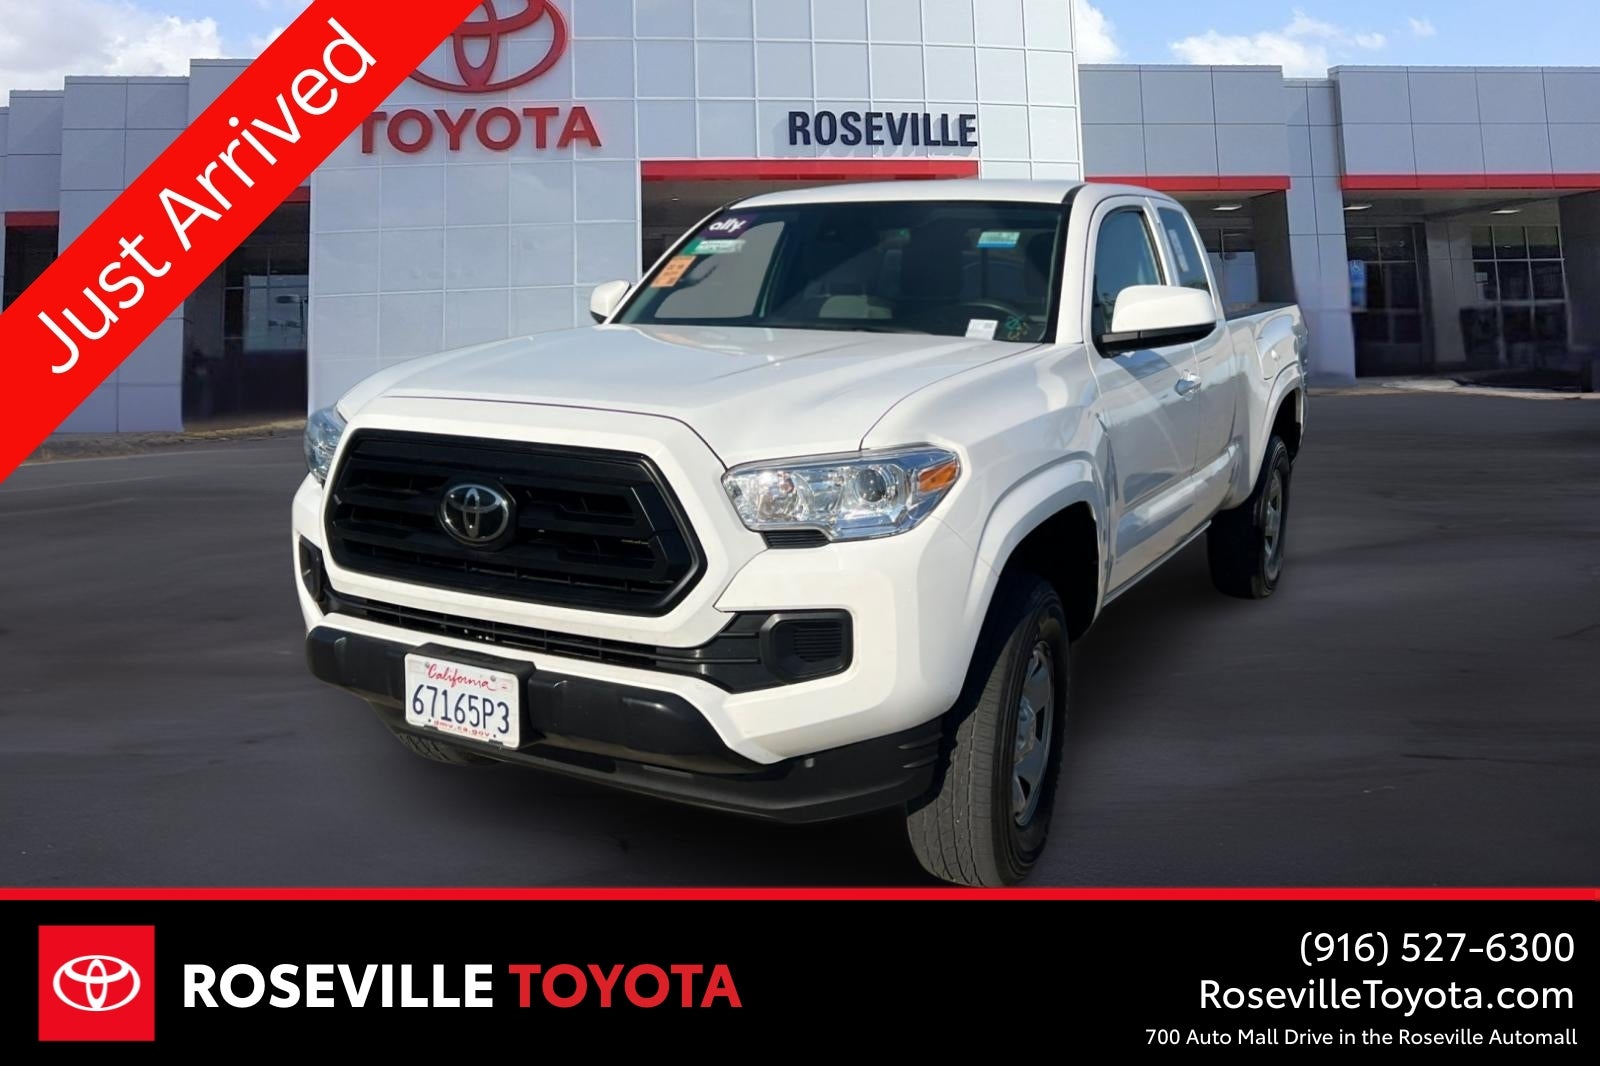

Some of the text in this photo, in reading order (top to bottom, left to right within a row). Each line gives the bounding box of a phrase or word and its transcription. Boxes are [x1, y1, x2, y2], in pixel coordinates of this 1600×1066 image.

[361, 106, 602, 153] TOYOTA
[788, 111, 978, 147] ROSEVILLE
[709, 218, 746, 233] ally
[427, 663, 496, 691] California
[412, 684, 509, 734] 67165P3
